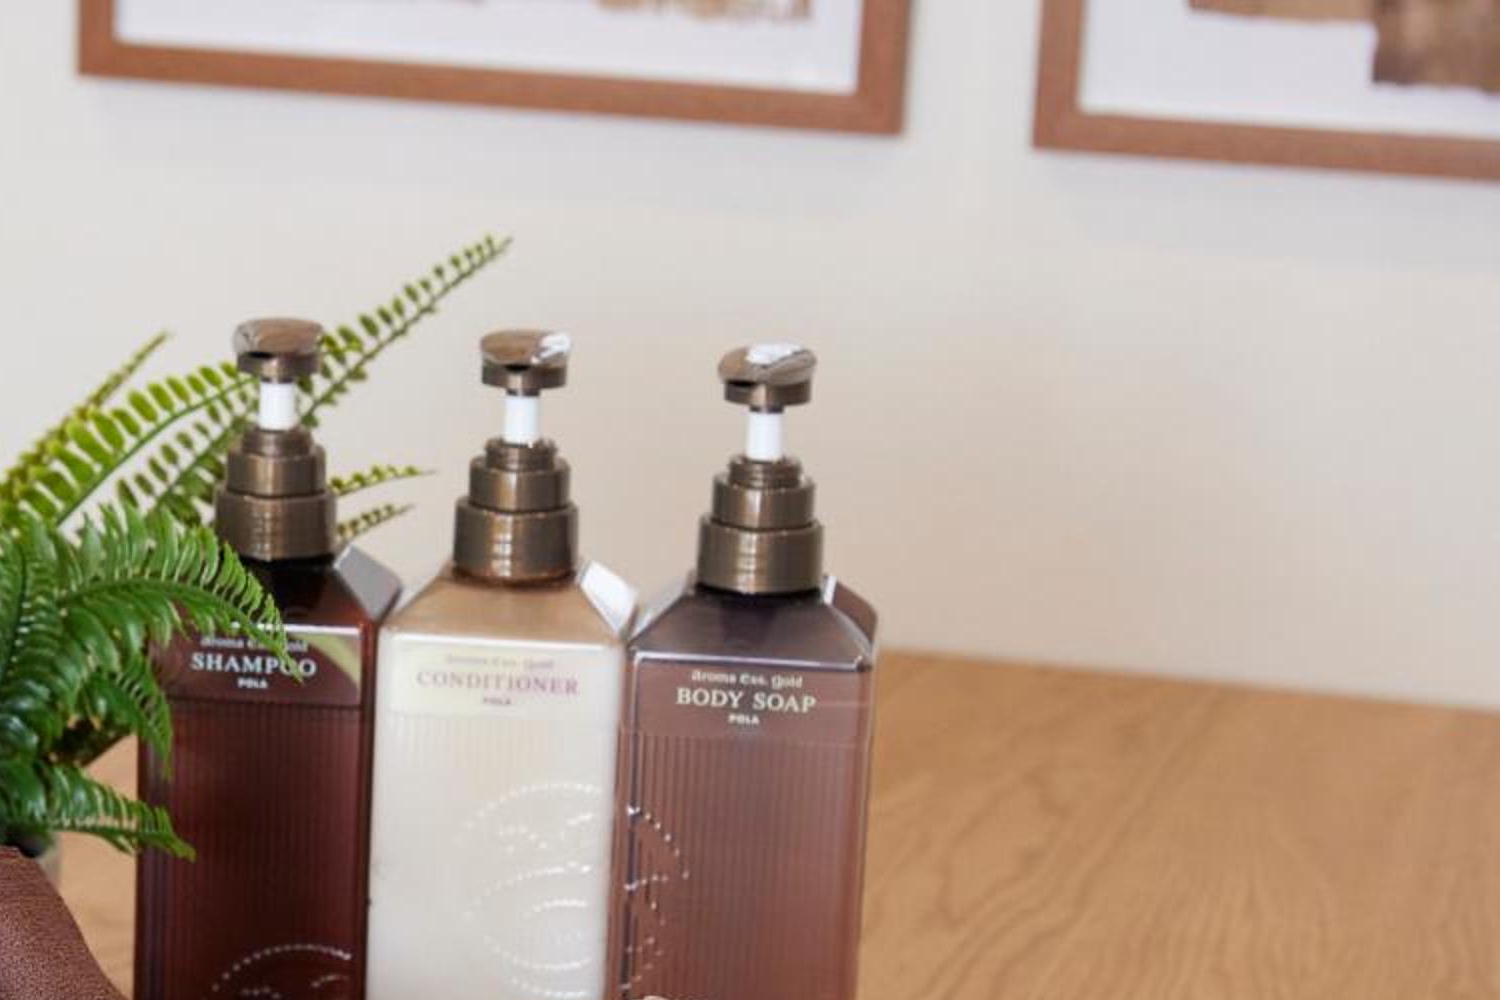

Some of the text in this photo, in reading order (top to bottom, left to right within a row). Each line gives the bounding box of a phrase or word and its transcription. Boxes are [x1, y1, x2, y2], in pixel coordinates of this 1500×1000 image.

[191, 652, 317, 677] SHAMPOO
[416, 670, 579, 694] CONDITIONER
[676, 687, 818, 713] BODY SOAP
[728, 713, 760, 725] POLA
